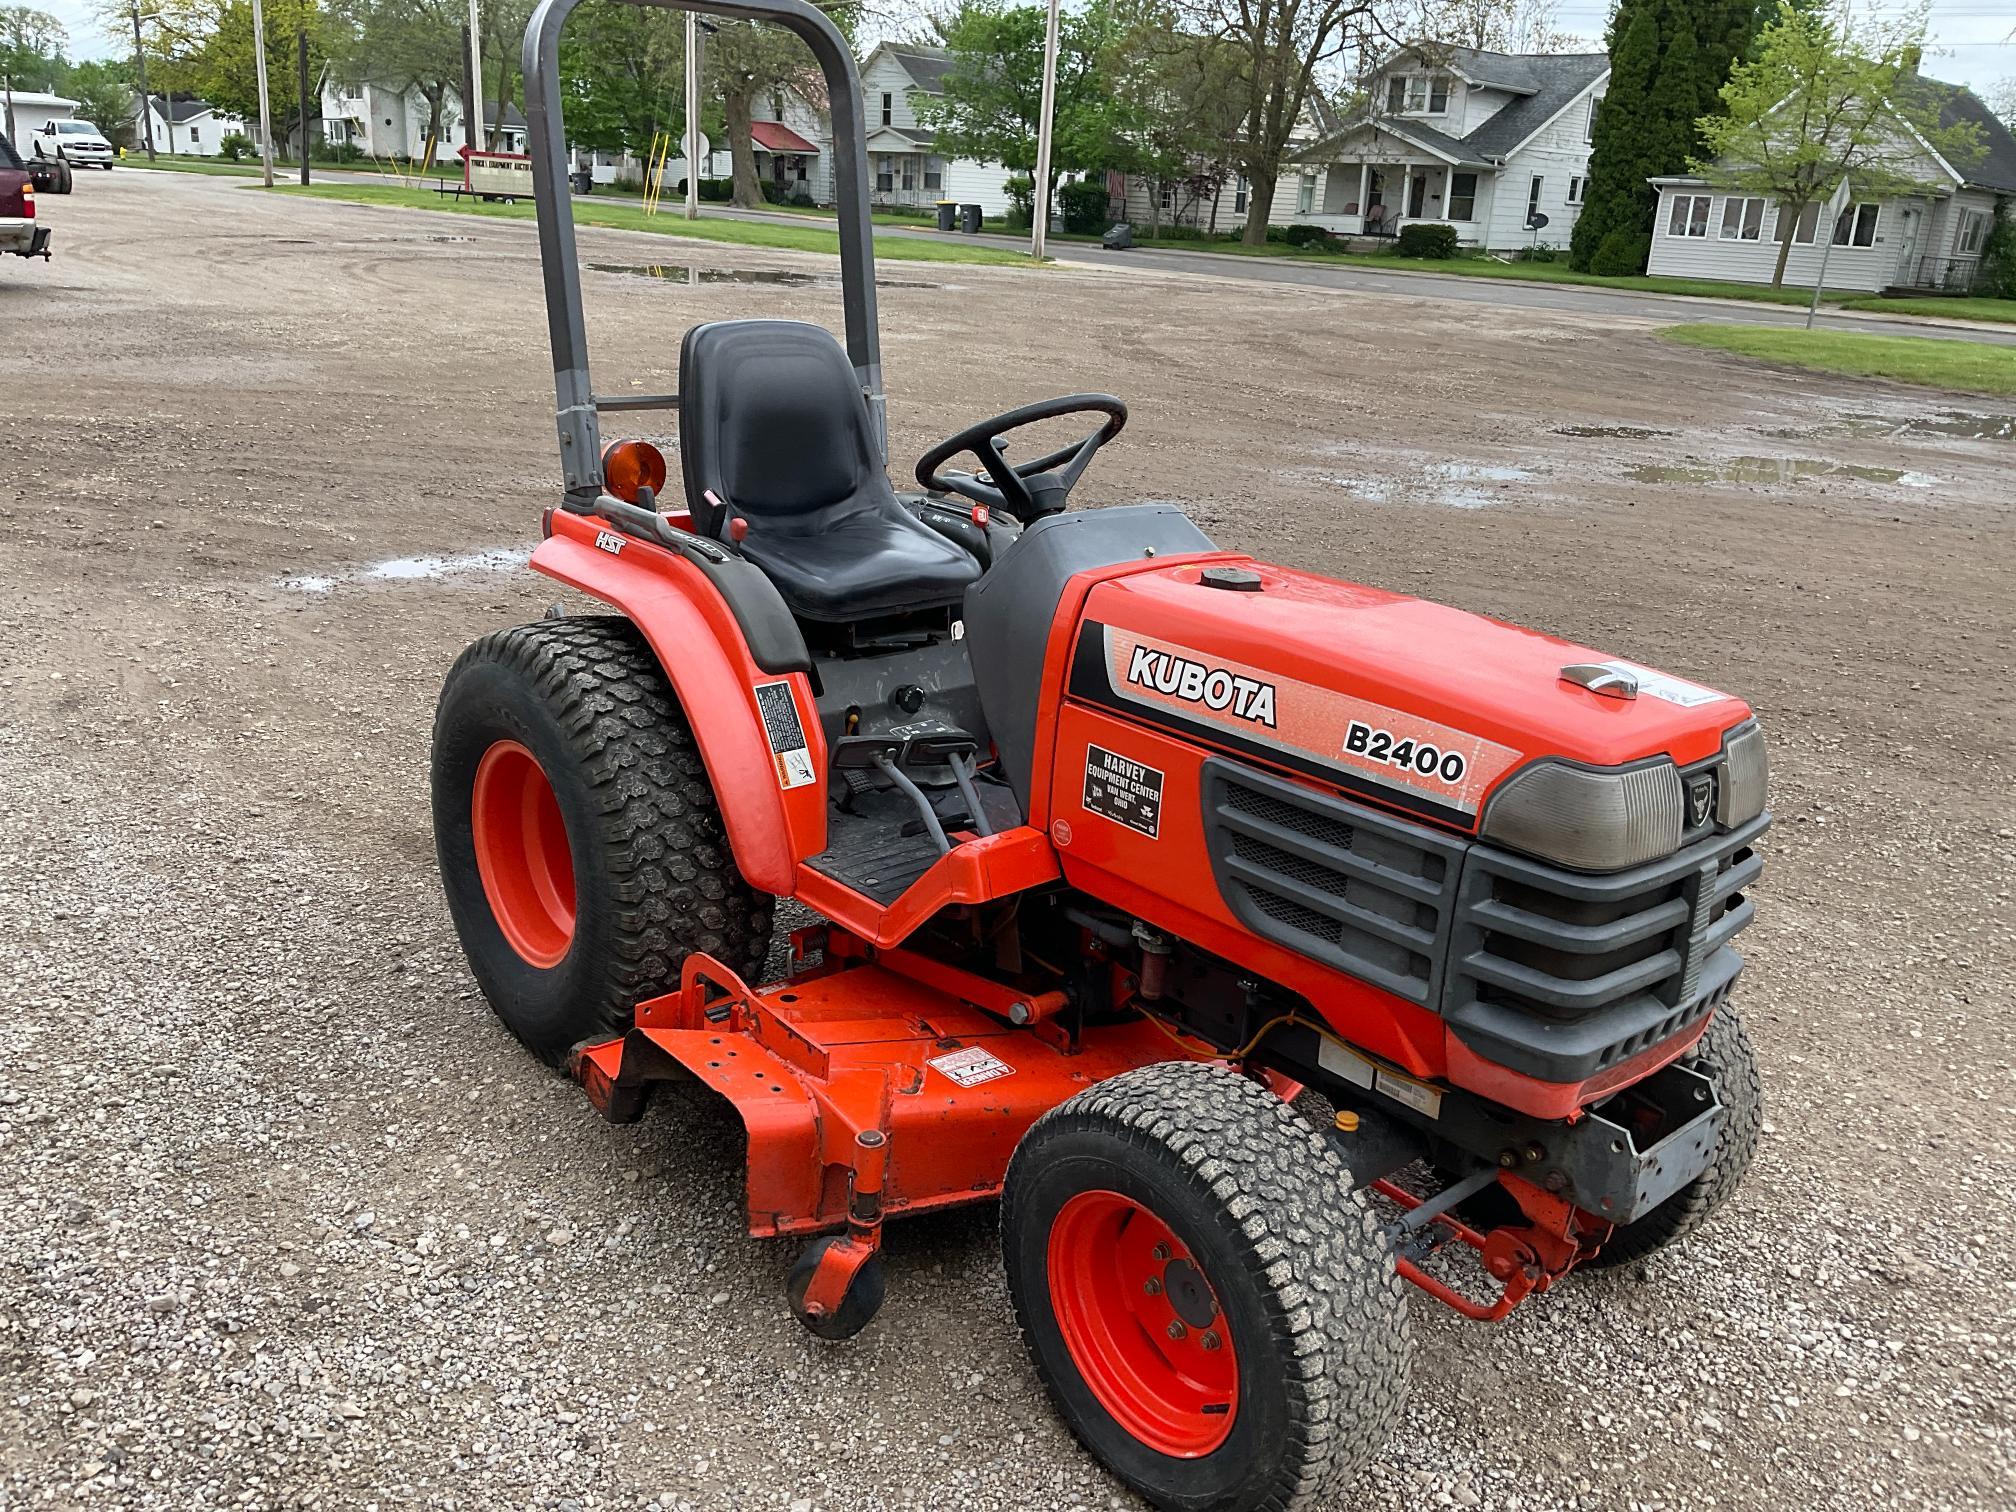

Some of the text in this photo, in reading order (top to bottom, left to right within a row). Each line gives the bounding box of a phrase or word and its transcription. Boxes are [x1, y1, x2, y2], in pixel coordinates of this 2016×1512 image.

[595, 531, 627, 555] HST
[1127, 644, 1278, 730] KUBOTA
[1344, 721, 1466, 783] B2400
[1088, 763, 1160, 803] EQUIPMENT CENTER
[1104, 753, 1146, 783] HARVEY
[1107, 784, 1119, 796] VAN
[1113, 796, 1128, 810] OHIO
